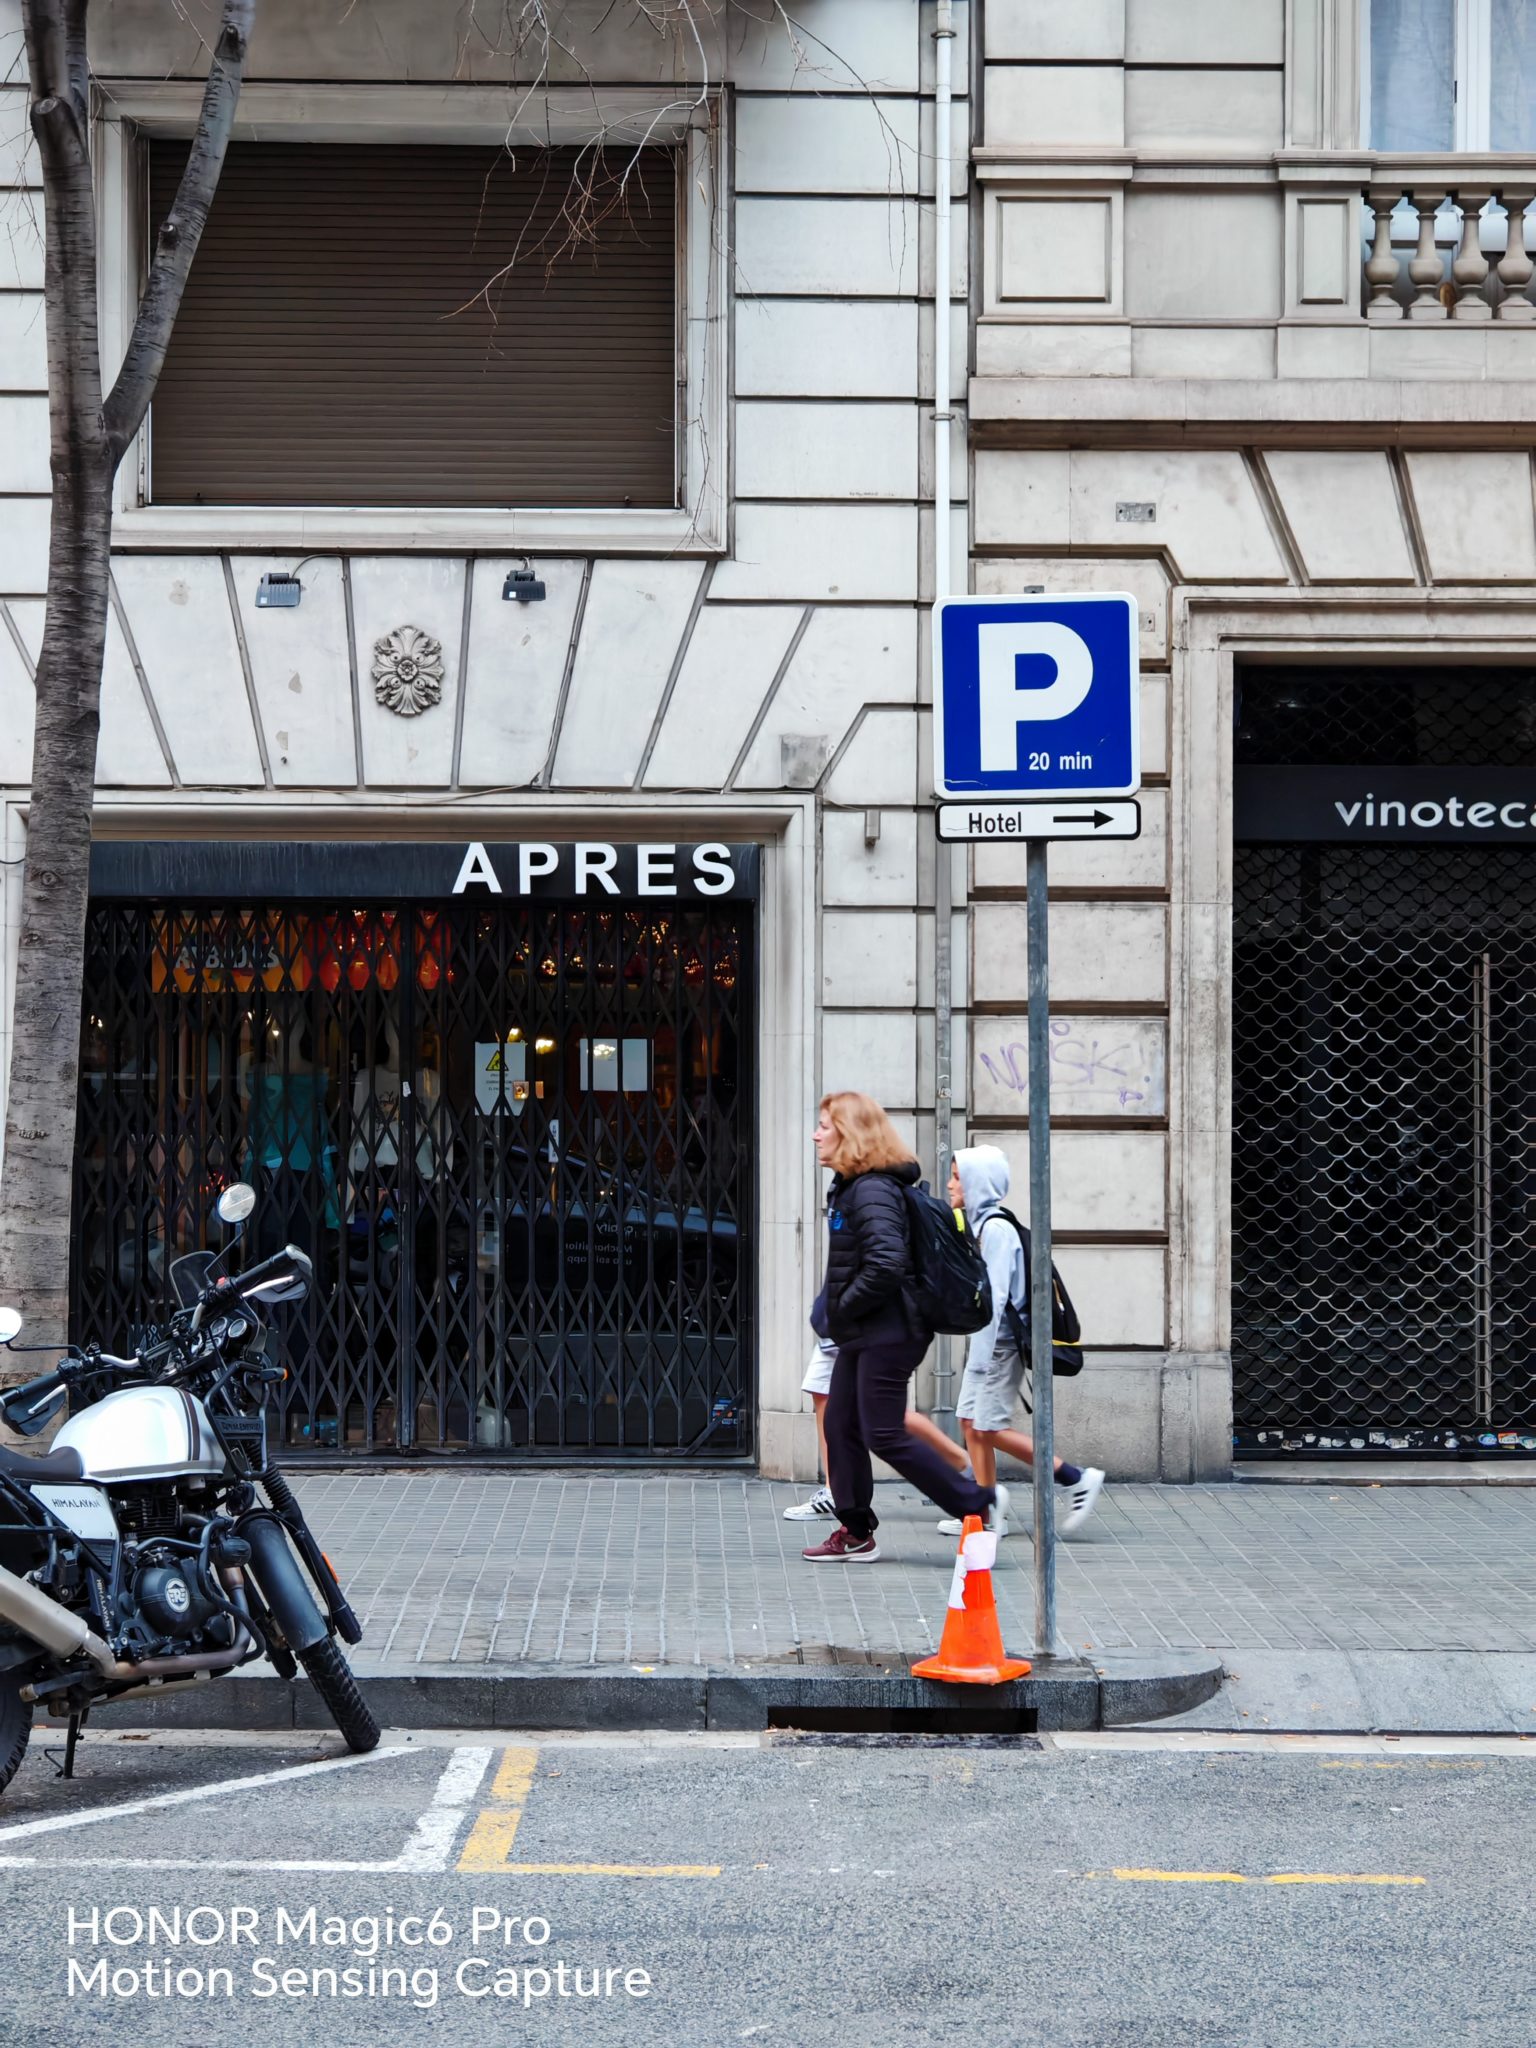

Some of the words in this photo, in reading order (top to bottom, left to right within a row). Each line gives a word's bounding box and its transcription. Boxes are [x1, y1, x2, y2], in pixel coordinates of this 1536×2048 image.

[978, 622, 1094, 772] P
[1028, 752, 1050, 770] 20
[1059, 751, 1093, 770] min
[968, 812, 1022, 834] Hotel
[1334, 793, 1536, 828] vinotec
[452, 842, 735, 896] APRES
[52, 1498, 101, 1508] HIMALAYAN
